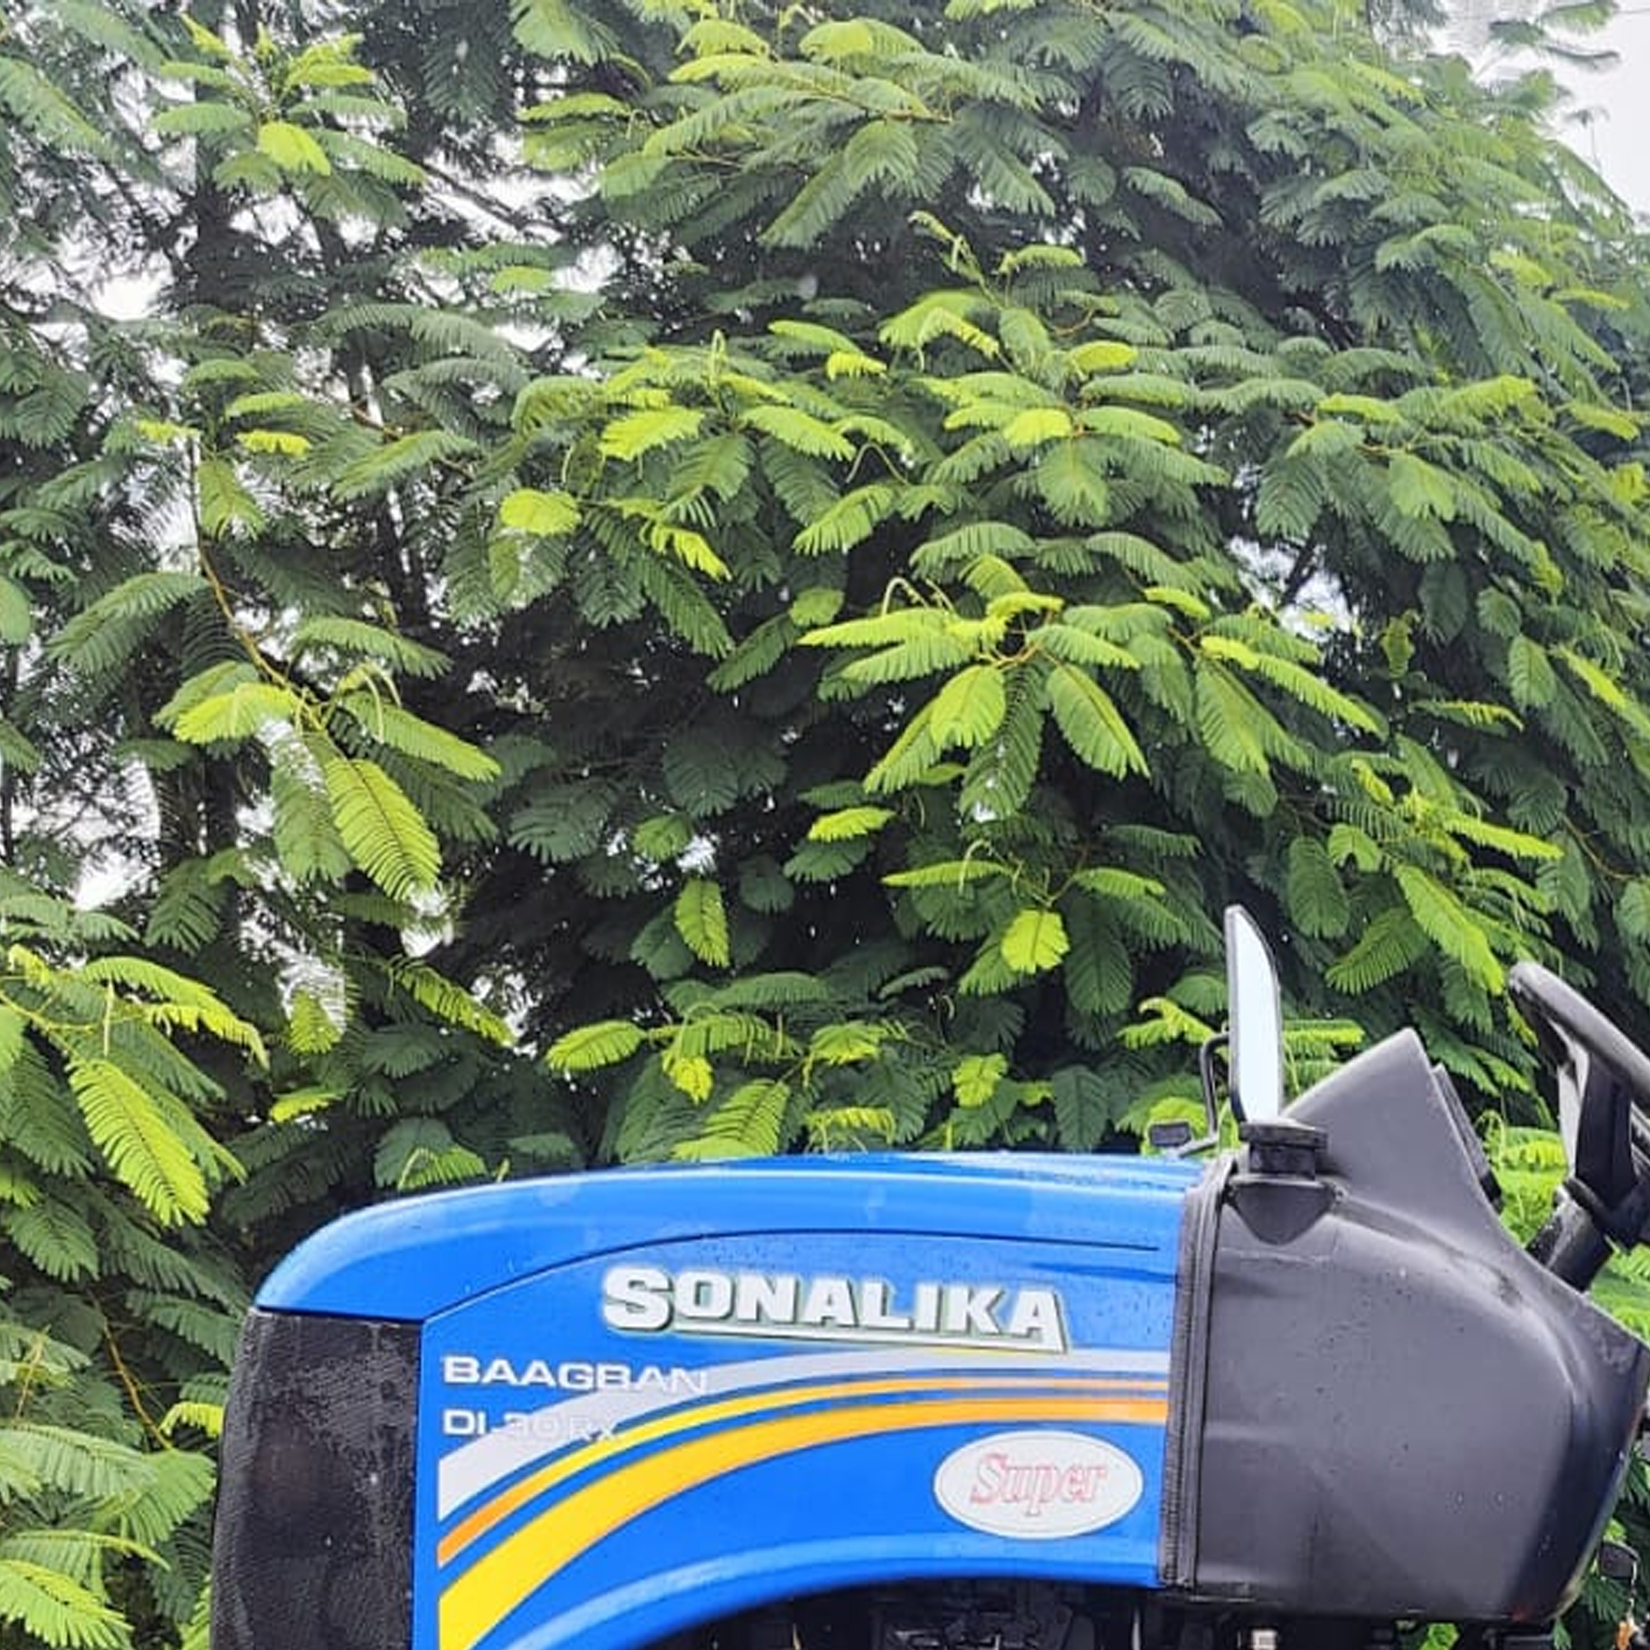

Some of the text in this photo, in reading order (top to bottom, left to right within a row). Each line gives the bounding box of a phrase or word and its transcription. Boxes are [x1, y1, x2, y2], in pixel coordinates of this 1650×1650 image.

[602, 1264, 1069, 1353] SONALIKA
[442, 1355, 708, 1394] BAAGBAN
[442, 1409, 486, 1436] DI
[971, 1453, 1108, 1517] Super
